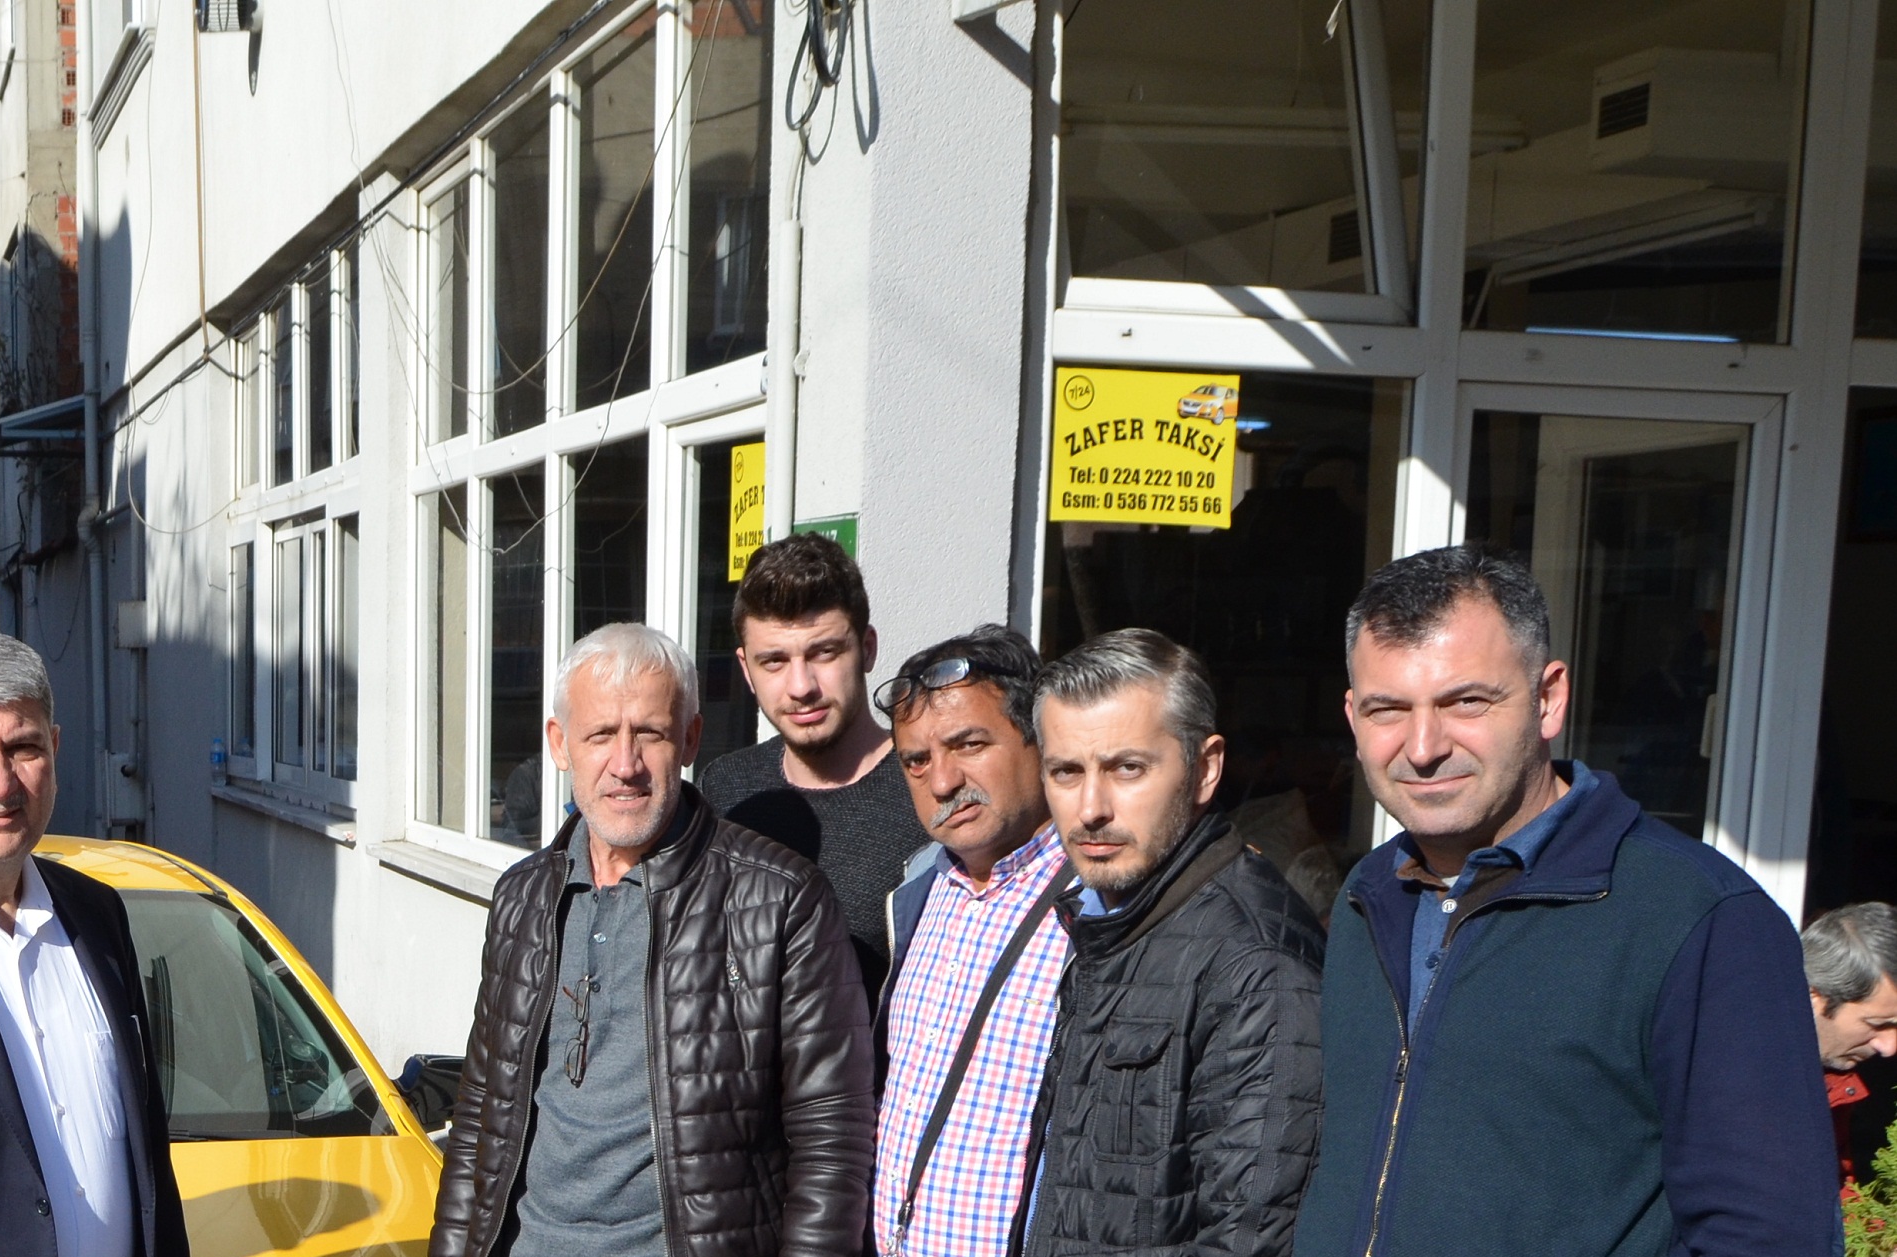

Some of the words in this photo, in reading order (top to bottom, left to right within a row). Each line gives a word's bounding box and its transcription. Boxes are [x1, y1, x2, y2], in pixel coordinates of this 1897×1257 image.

[1068, 384, 1091, 401] 7/24
[1064, 418, 1144, 457] ZAFER
[1154, 418, 1226, 463] TAKSİ
[1069, 466, 1096, 484] Tel:
[1099, 466, 1109, 484] 0
[1112, 467, 1141, 485] 224
[1144, 468, 1172, 487] 222
[1176, 470, 1193, 488] 10
[1196, 471, 1216, 489] 20
[734, 485, 759, 524] ZAFER
[1061, 491, 1101, 509] Gsm:
[1103, 491, 1114, 509] 0
[1117, 492, 1147, 510] 536
[1151, 493, 1175, 511] 772
[1179, 495, 1198, 513] 55
[1202, 496, 1222, 514] 66
[748, 530, 757, 546] 224
